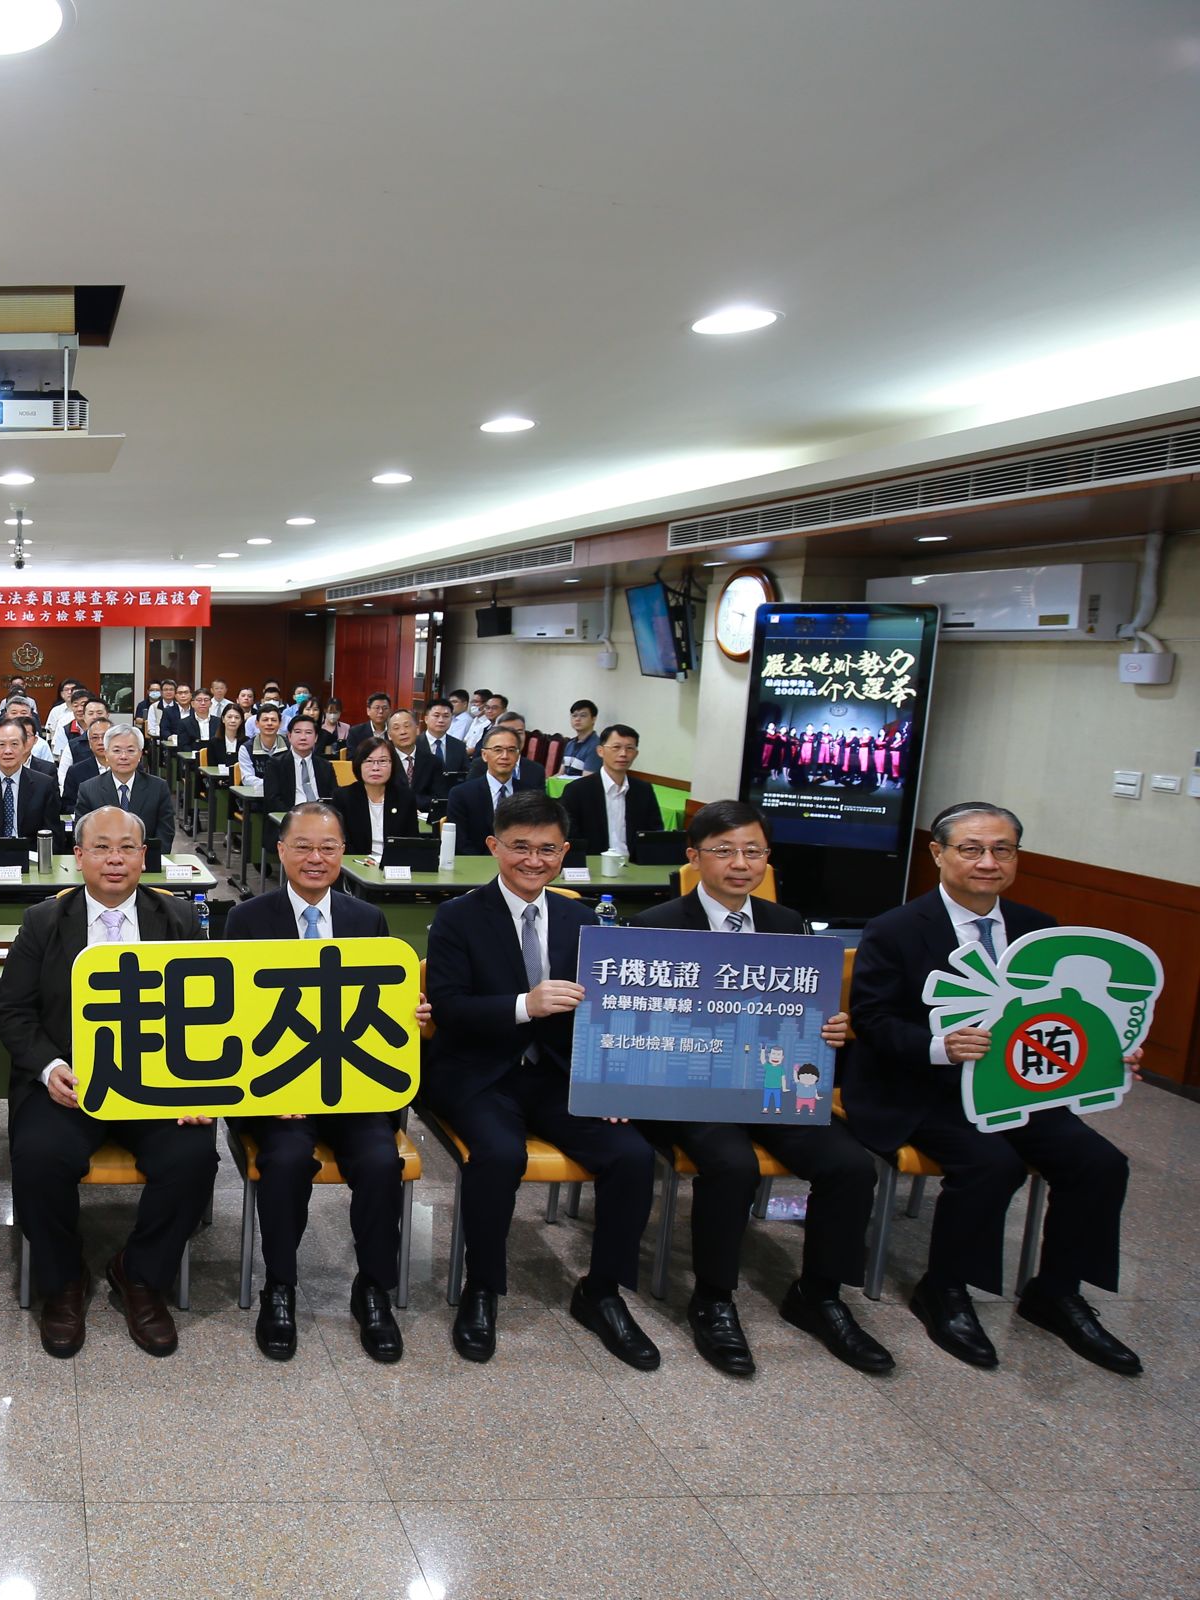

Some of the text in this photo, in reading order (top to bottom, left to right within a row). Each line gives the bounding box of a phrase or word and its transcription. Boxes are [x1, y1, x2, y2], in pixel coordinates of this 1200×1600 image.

[590, 958, 820, 994] 手機蒐證 全民反賄
[82, 945, 412, 1113] 起來
[599, 1033, 724, 1055] 臺北地檢署 關心您
[1020, 1025, 1073, 1077] 賄
